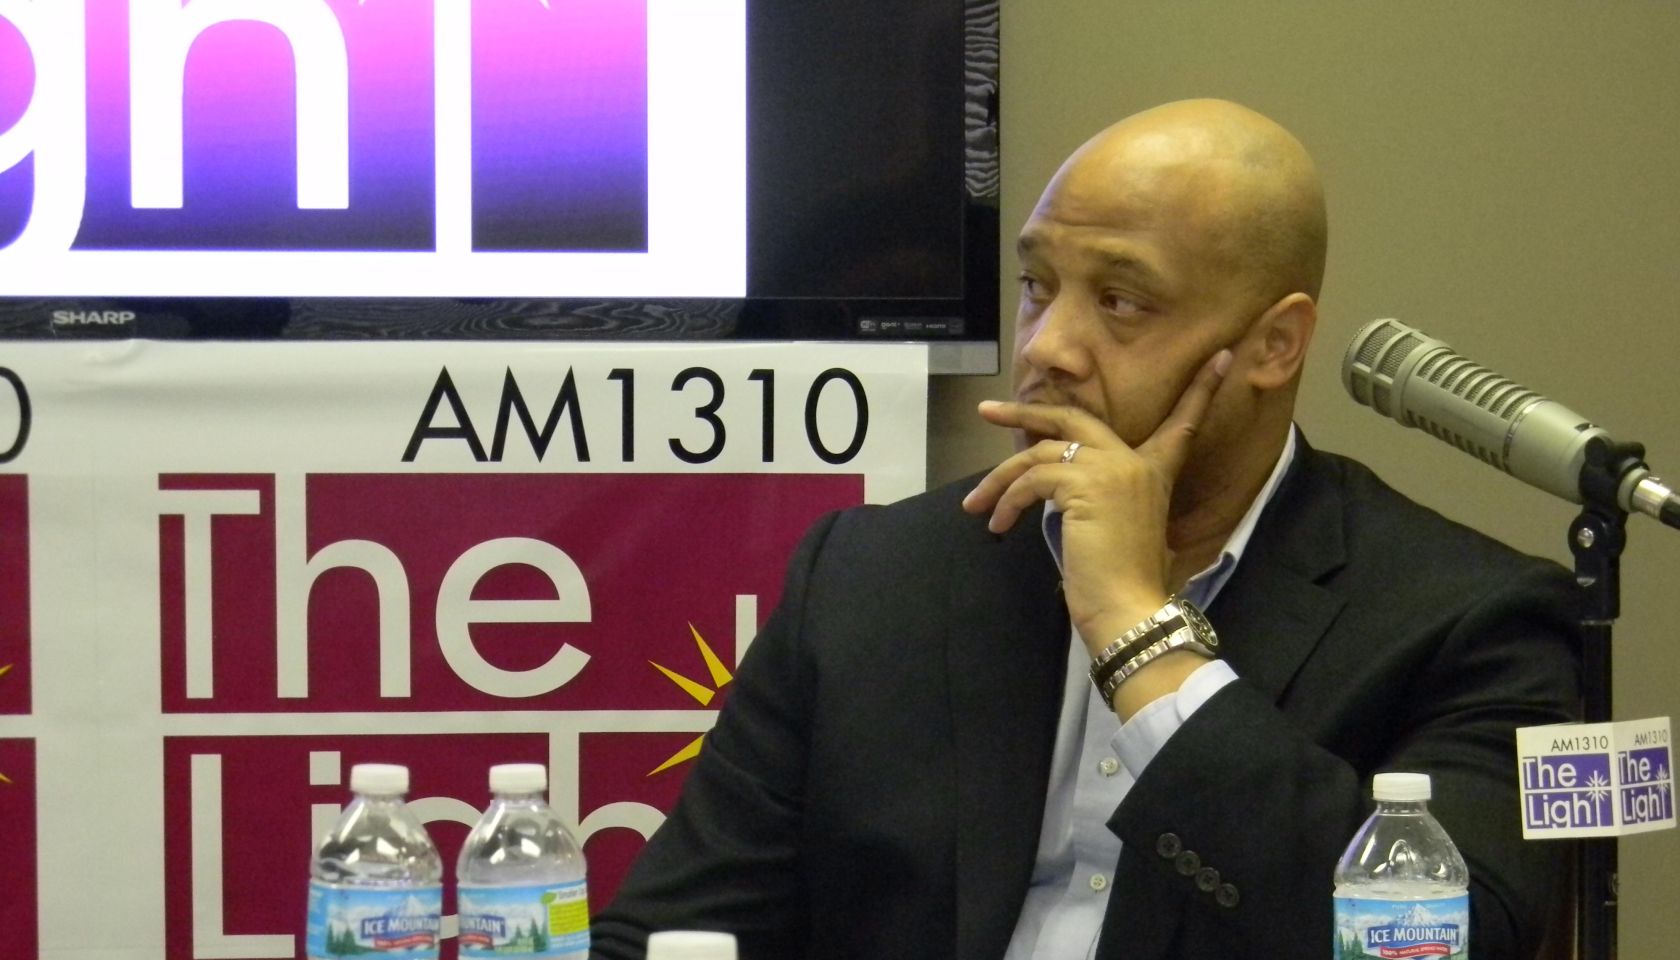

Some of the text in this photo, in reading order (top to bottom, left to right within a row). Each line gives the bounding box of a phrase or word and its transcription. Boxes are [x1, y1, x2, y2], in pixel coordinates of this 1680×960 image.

[53, 310, 136, 325] SHARP
[402, 365, 869, 465] AM1310
[159, 473, 592, 699] The
[1551, 735, 1609, 752] AM1310
[1634, 730, 1669, 746] AM1310
[1522, 756, 1577, 789] The
[1618, 751, 1651, 783] The
[364, 919, 386, 935] ICE
[1370, 927, 1457, 943] ICE MOUNTAIN
